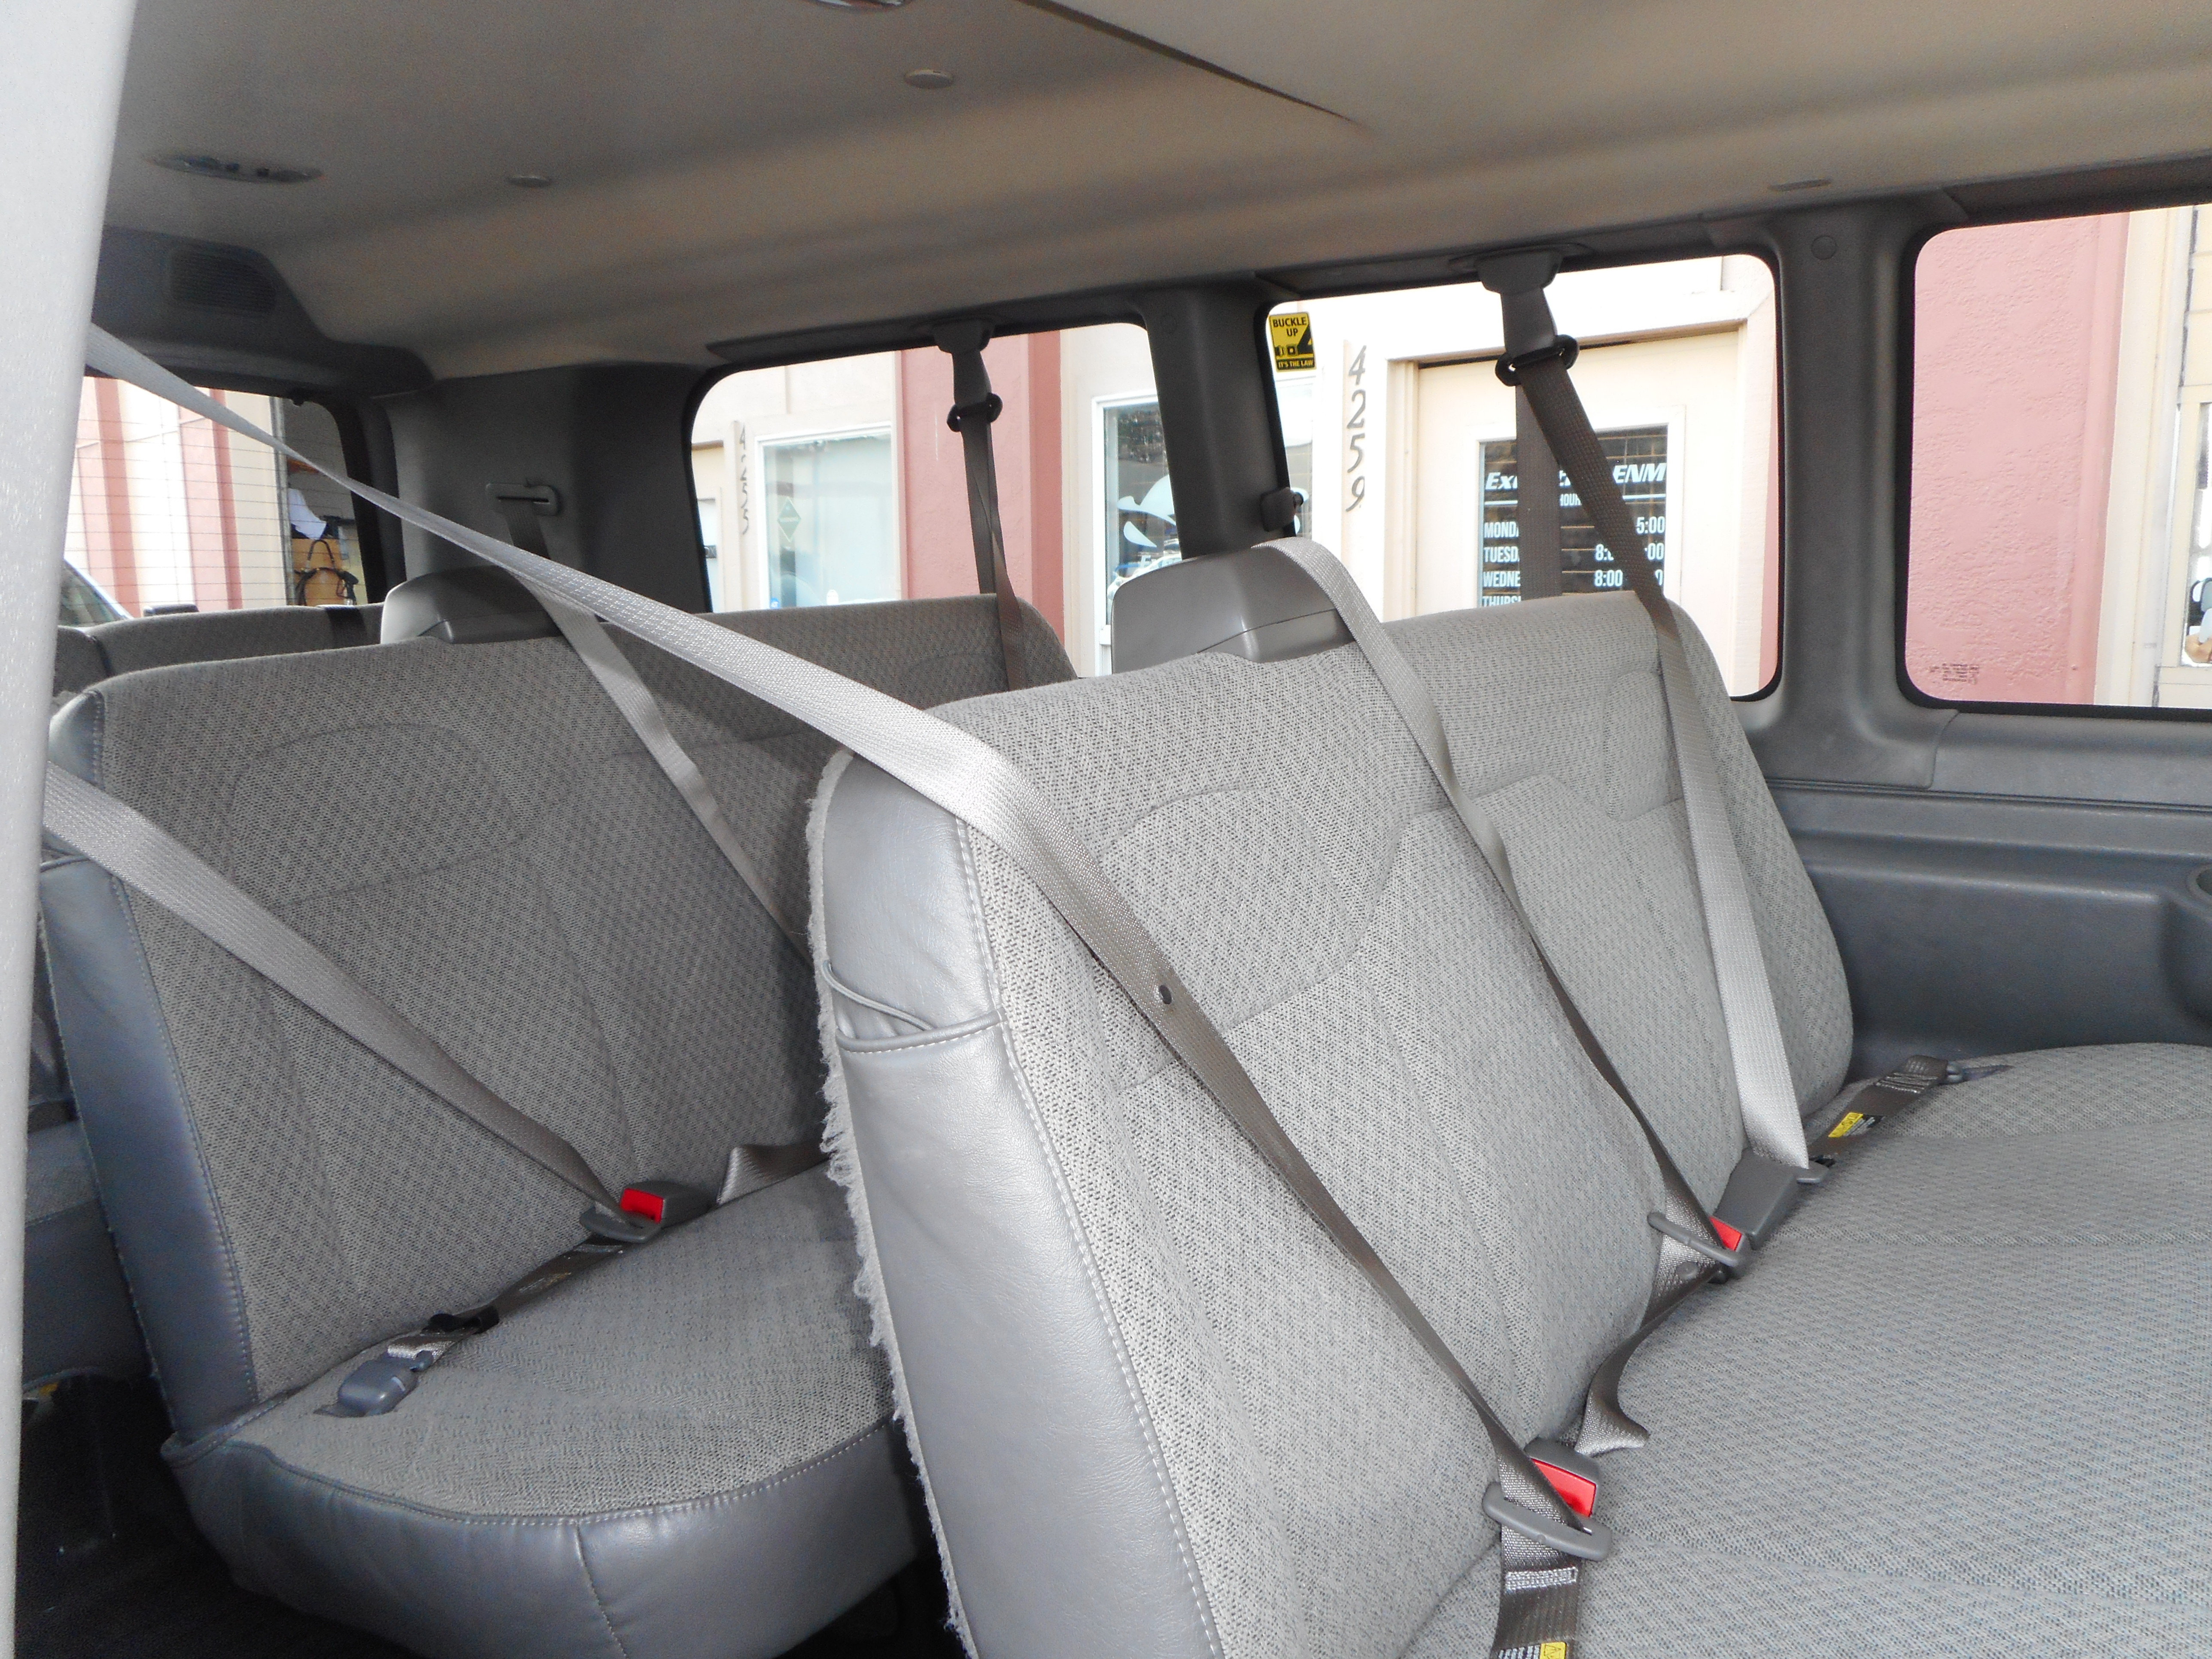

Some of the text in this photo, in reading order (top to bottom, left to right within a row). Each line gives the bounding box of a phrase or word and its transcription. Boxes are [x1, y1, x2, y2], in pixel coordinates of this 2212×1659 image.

[1273, 317, 1307, 327] BUCKLE
[1286, 328, 1298, 337] UP
[1346, 345, 1367, 512] 4259
[1560, 493, 1582, 506] OUR
[1484, 516, 1665, 538] MOND 5:00
[1483, 546, 1520, 562] TUESD
[1483, 569, 1623, 587] WEDNE 8:00
